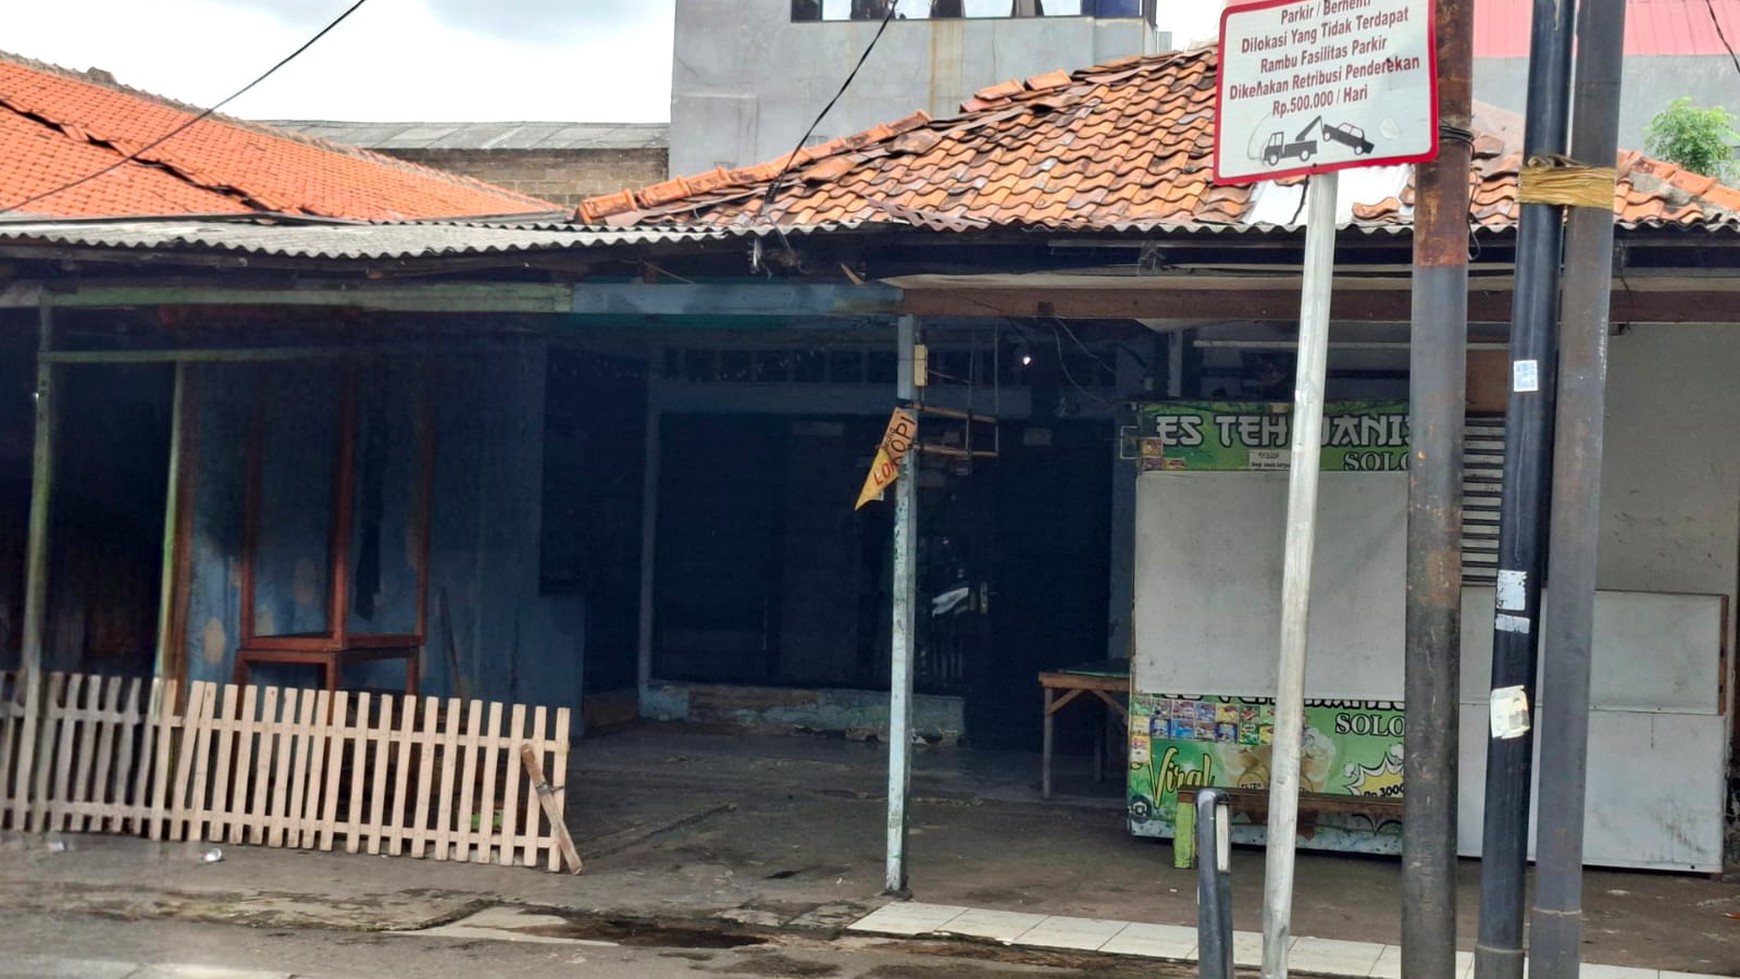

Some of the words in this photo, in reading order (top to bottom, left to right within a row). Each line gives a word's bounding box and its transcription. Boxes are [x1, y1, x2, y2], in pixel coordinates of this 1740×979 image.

[1242, 32, 1287, 53] Dilokasi
[1292, 29, 1317, 44] Yang
[1321, 19, 1351, 38] Tidak
[1356, 7, 1409, 29] Terdapat
[1281, 5, 1314, 25] Parkir
[1316, 2, 1320, 17] /
[1261, 54, 1297, 73] Rambu
[1301, 45, 1347, 65] Fasilitas
[1352, 35, 1387, 55] Parkir
[1230, 79, 1288, 100] Dikenakan
[1293, 66, 1342, 88] Retribusi
[1346, 56, 1420, 79] Penderekan
[1273, 91, 1333, 118] Rp.500.000
[1336, 88, 1340, 104] /
[1344, 84, 1368, 103] Hari
[1156, 414, 1203, 447] ES
[1214, 413, 1288, 448] TEH
[1335, 713, 1404, 737] SOLO
